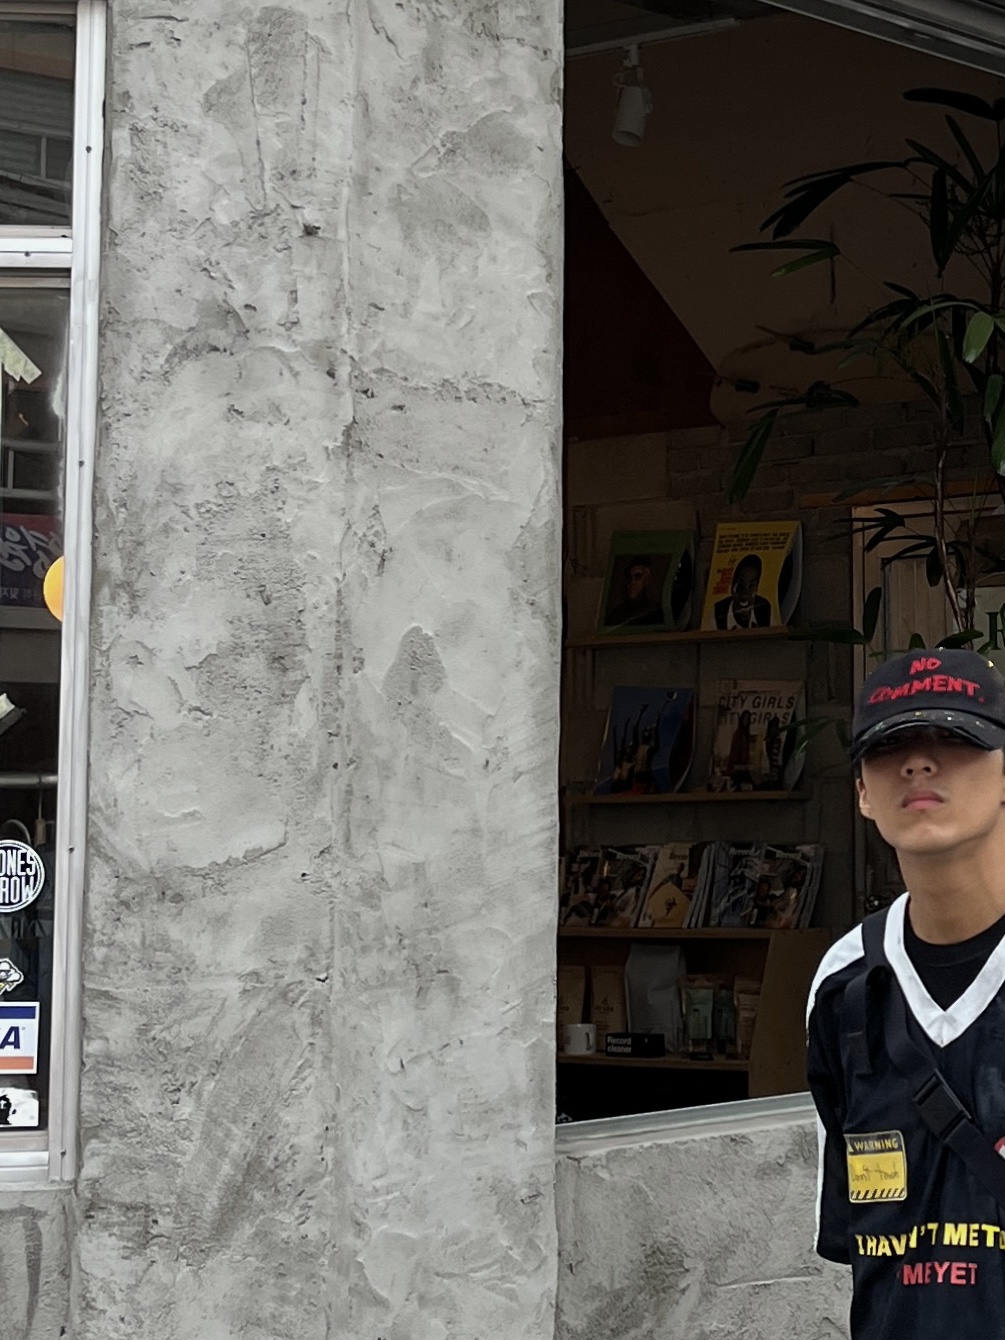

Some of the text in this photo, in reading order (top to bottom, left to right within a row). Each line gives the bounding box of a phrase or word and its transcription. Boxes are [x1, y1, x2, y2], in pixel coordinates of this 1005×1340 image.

[908, 656, 942, 676] NO
[718, 694, 796, 709] CITY GIRLS
[607, 1035, 632, 1045] Record
[853, 1137, 899, 1152] WARNING
[943, 1222, 1001, 1248] MET
[932, 1260, 979, 1286] YET
